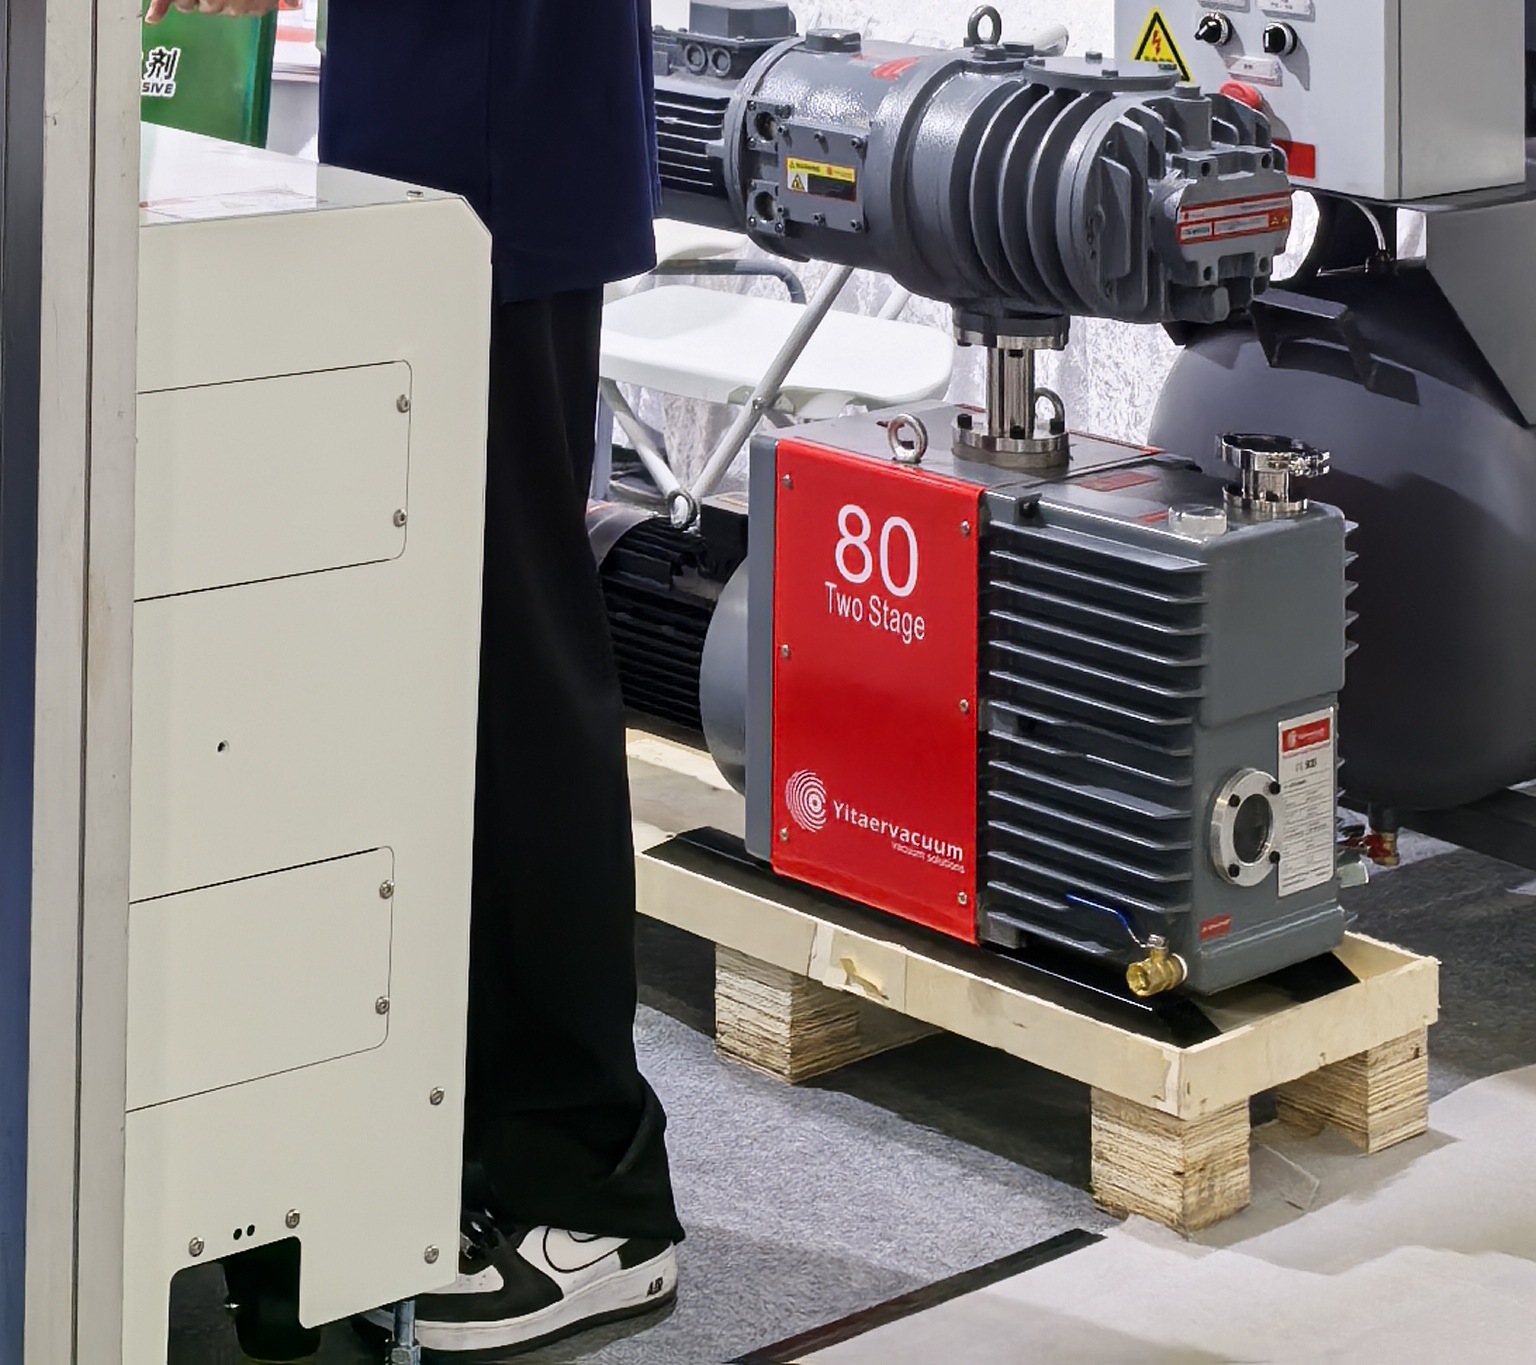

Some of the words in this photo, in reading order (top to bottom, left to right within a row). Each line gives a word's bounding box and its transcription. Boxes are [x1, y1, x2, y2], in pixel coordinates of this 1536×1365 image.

[835, 503, 918, 597] 80
[824, 580, 864, 622] Two
[868, 593, 926, 645] Stage
[833, 800, 964, 862] Yitaervacuum
